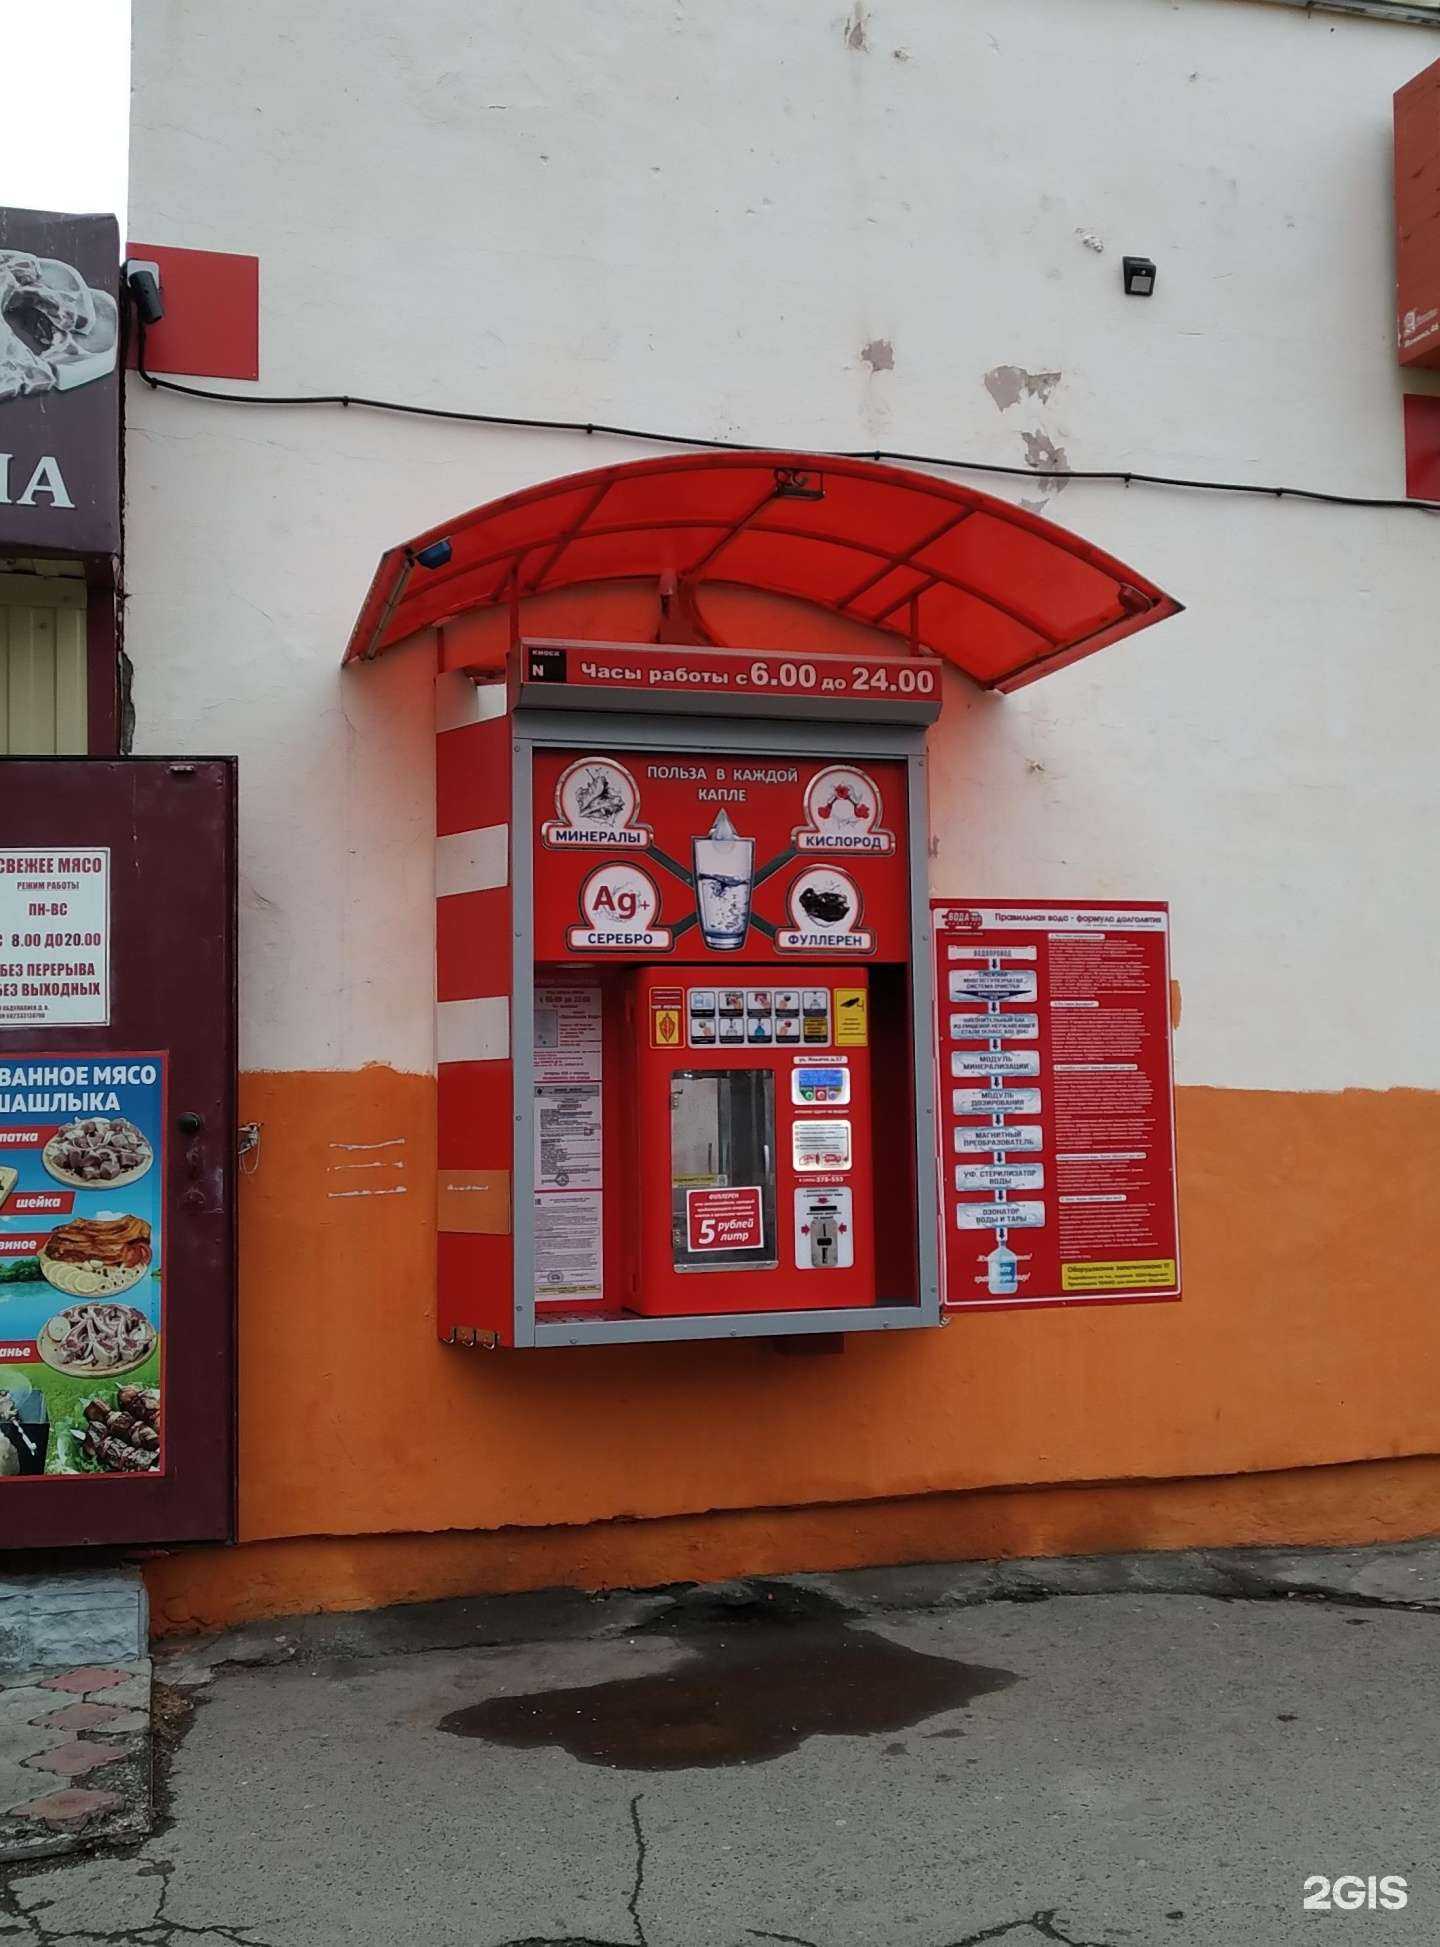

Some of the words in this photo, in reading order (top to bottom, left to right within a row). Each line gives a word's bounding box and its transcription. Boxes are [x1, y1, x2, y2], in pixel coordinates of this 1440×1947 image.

[580, 662, 642, 680] Часы
[648, 667, 729, 685] работы
[735, 673, 748, 685] с
[750, 662, 817, 688] 6.00
[821, 678, 847, 691] до
[851, 667, 935, 693] 24.00
[647, 766, 707, 780] ПОЛЬЗА
[716, 768, 725, 781] В
[732, 767, 798, 783] КАЖДОЙ
[698, 788, 747, 802] КАПЛЕ
[555, 830, 641, 844] МИНЕРАЛЫ
[805, 835, 882, 850] КИСЛОРОД
[0, 858, 54, 874] СВЕЖЕЕ
[58, 857, 102, 873] МЯСО
[17, 881, 45, 890] РЕЖИМ
[47, 881, 80, 890] РАБОТЫ
[29, 903, 68, 916] ПН-ВС
[994, 912, 1046, 922] Правильная
[1048, 914, 1069, 922] вода
[1076, 914, 1115, 924] формула
[1116, 916, 1162, 924] долголетия
[12, 933, 41, 947] 8.00
[587, 932, 653, 945] СЕРЕБРО
[787, 934, 863, 947] ФУЛЛЕРЕН
[0, 963, 23, 977] БЕЗ
[27, 962, 96, 977] ПЕРЕРЫВА
[22, 982, 101, 998] ВЫХОДНЫХ
[93, 1065, 157, 1085] МЯСО
[16, 1195, 61, 1208] шейка
[698, 1219, 715, 1245] 5
[717, 1218, 754, 1232] рублей
[719, 1231, 749, 1243] литр
